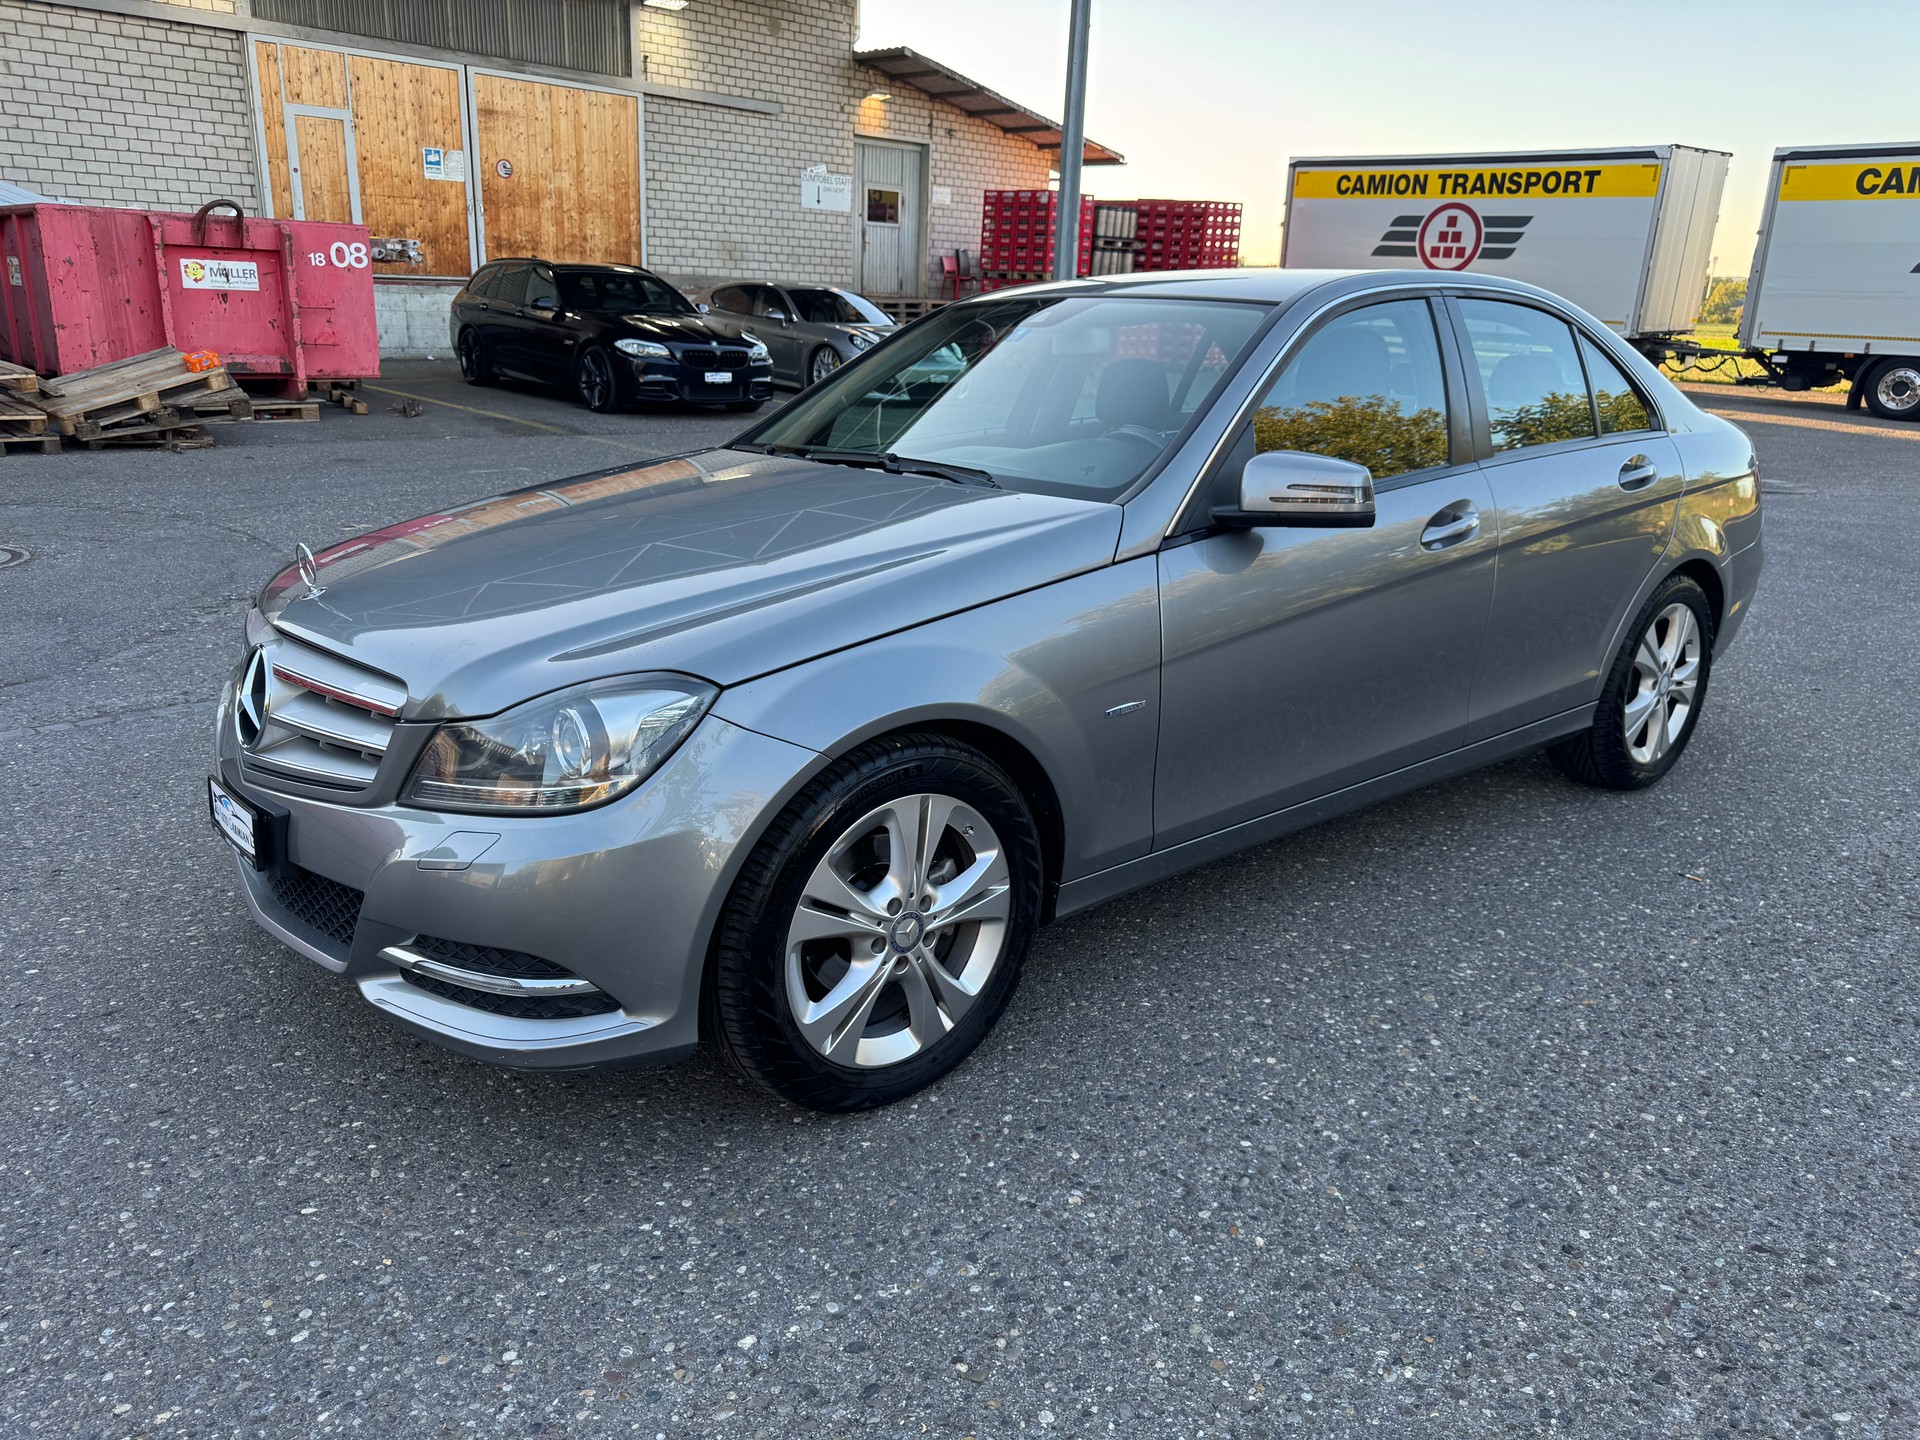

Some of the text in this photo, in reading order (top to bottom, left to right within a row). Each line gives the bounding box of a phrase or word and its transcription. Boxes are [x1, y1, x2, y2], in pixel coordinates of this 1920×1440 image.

[802, 173, 834, 185] ZUMTOBEL
[1336, 170, 1602, 195] CAMION TRANSPORT
[308, 241, 369, 269] 18 08
